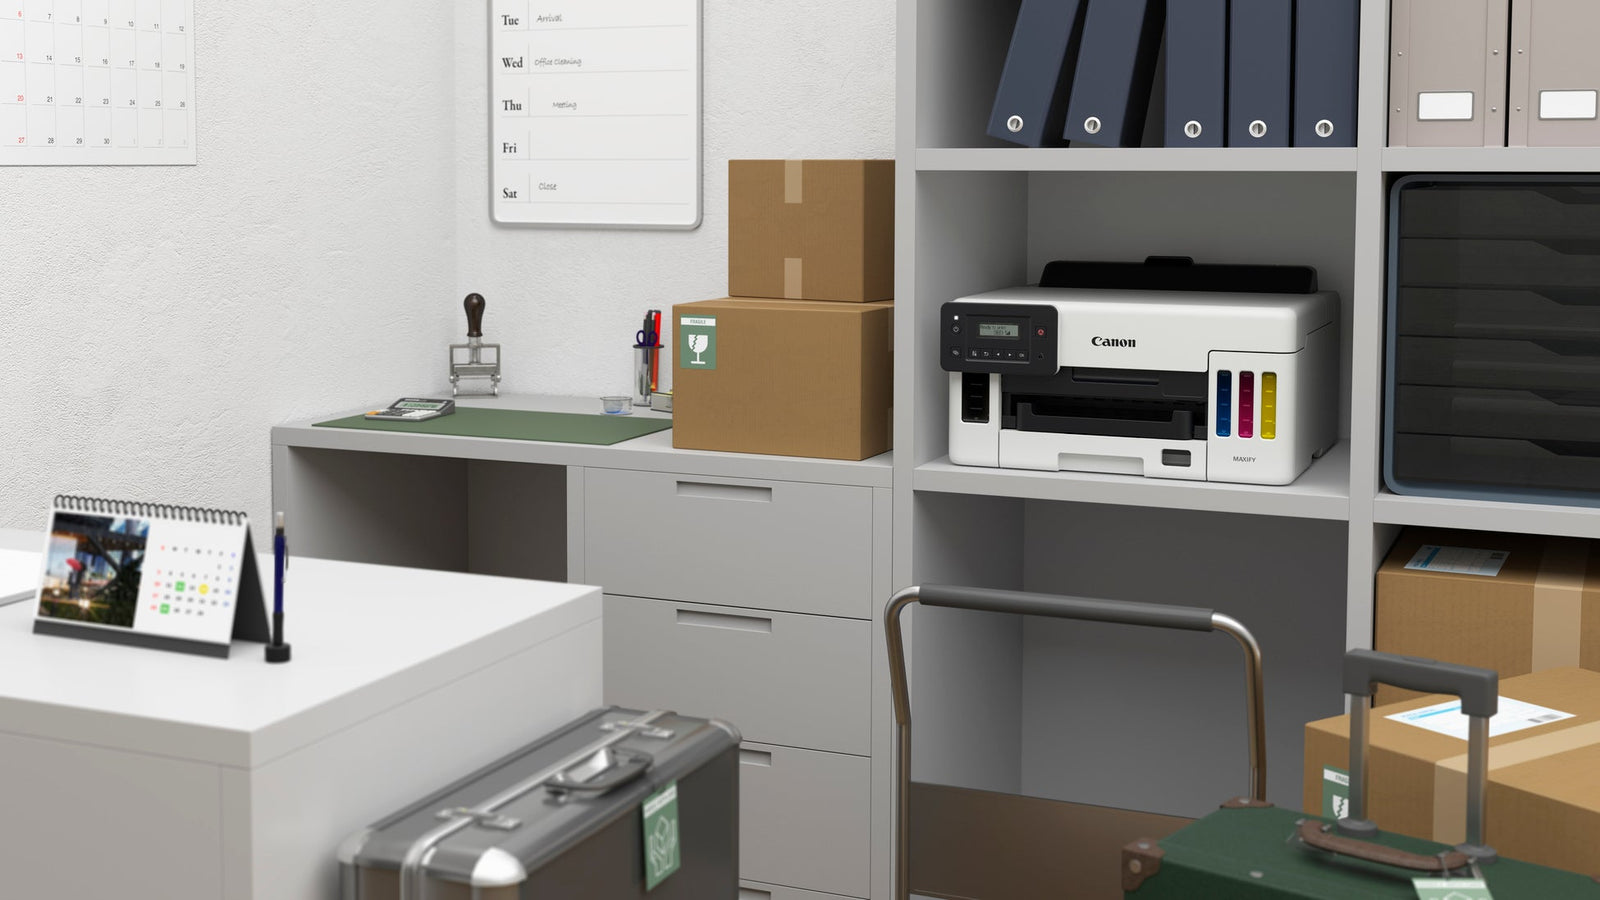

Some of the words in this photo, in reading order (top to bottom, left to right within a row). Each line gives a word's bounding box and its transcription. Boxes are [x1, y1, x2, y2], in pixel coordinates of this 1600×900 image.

[502, 15, 519, 25] Tue
[537, 14, 562, 22] Arrival
[502, 57, 523, 68] Wed
[535, 58, 552, 67] Office
[554, 58, 581, 67] Cleaning
[502, 100, 521, 110] Thu
[553, 102, 577, 110] Meeting
[503, 143, 516, 153] Fri
[503, 188, 517, 198] Sat
[1092, 336, 1136, 347] Canon
